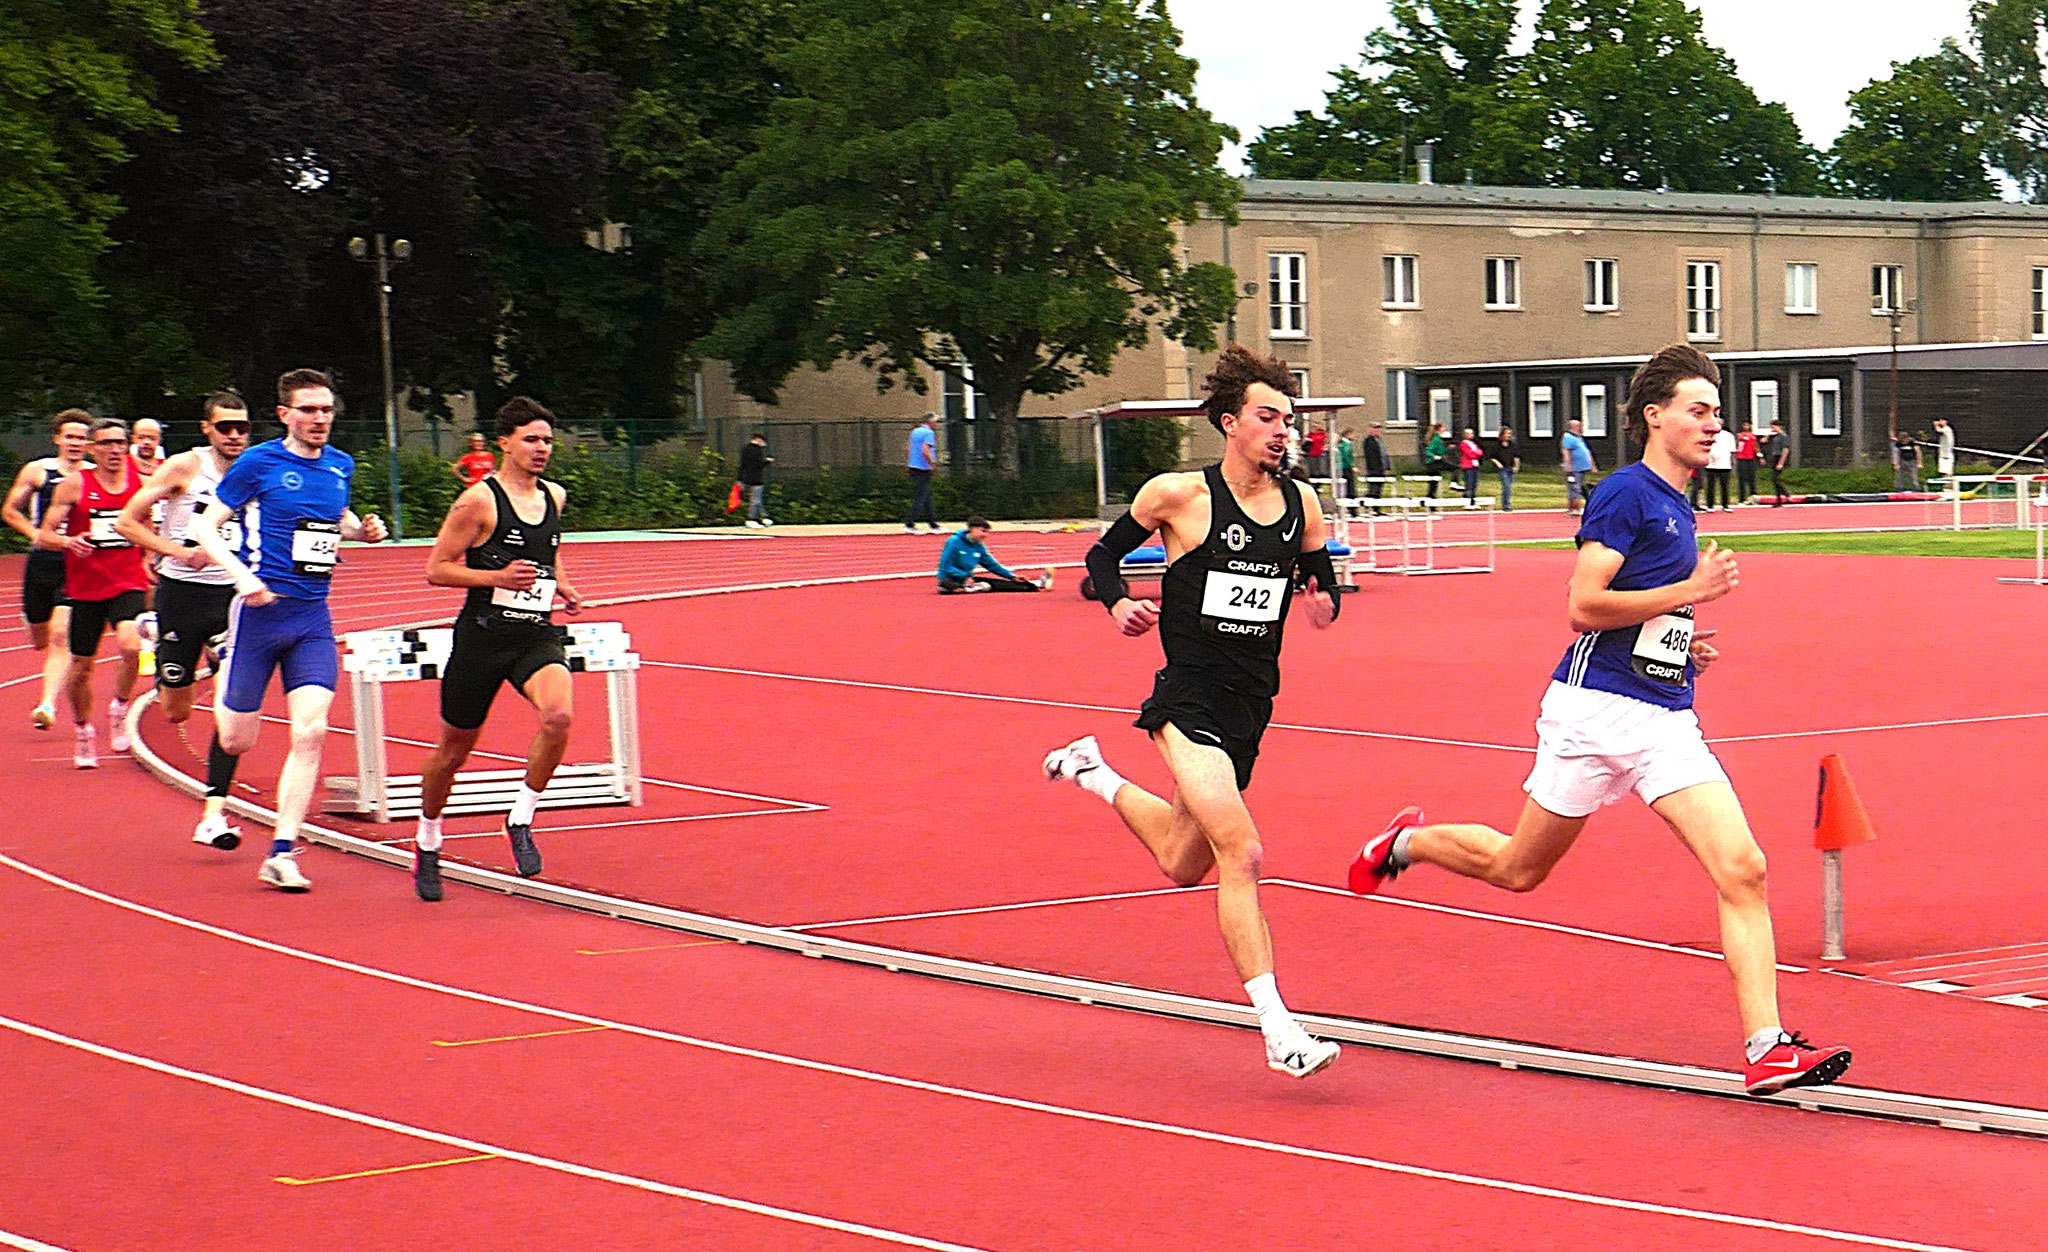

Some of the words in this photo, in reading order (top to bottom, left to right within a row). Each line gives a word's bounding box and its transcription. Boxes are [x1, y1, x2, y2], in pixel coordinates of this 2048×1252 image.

[1227, 560, 1272, 574] CRAFT
[1228, 586, 1271, 610] 242
[1217, 622, 1261, 635] CRAFT
[1660, 627, 1689, 652] 486
